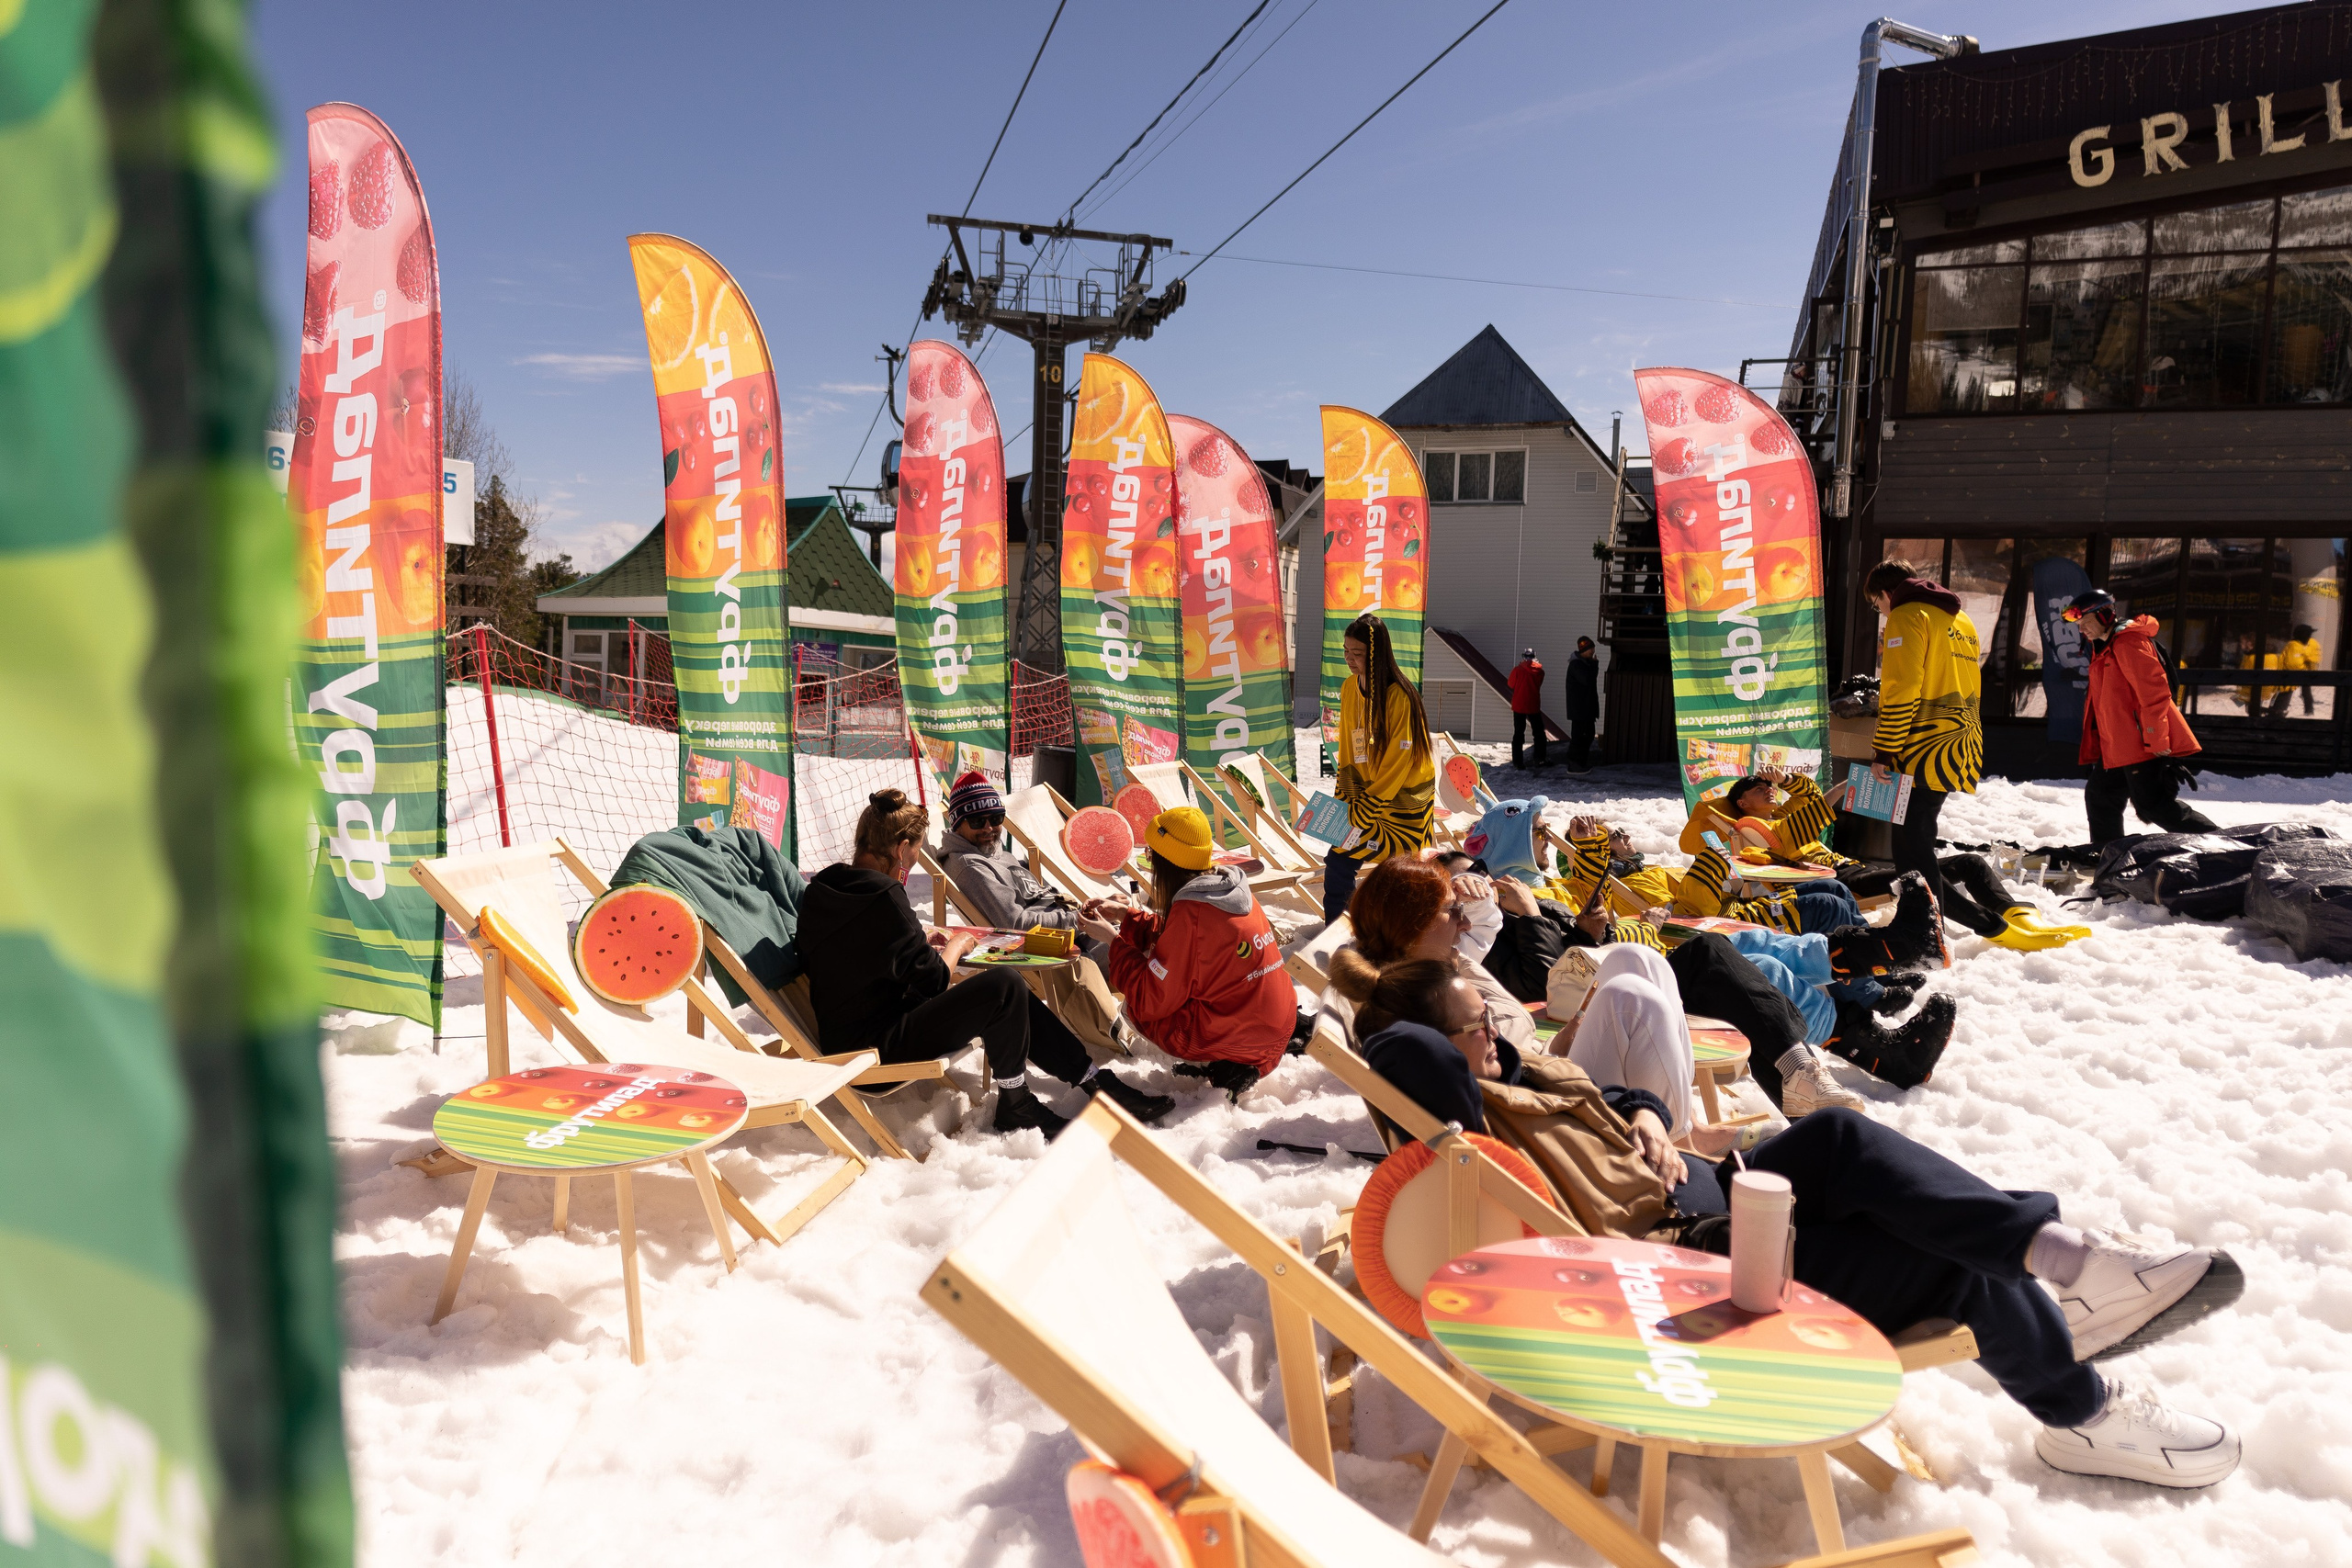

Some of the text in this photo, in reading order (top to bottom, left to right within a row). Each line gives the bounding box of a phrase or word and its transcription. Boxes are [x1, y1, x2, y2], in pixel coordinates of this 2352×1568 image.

[2067, 79, 2352, 188] GRILL
[1039, 365, 1062, 383] 10
[1851, 766, 1860, 781] 2024
[1857, 771, 1869, 807] БЛАГОДАРНОСТЬ
[1311, 793, 1323, 807] 2024
[1311, 800, 1332, 831] БЛАГОДАРНОСТЬ
[1317, 803, 1339, 834] ВОЛОНТЕРУ
[523, 1075, 667, 1150] фрутилад
